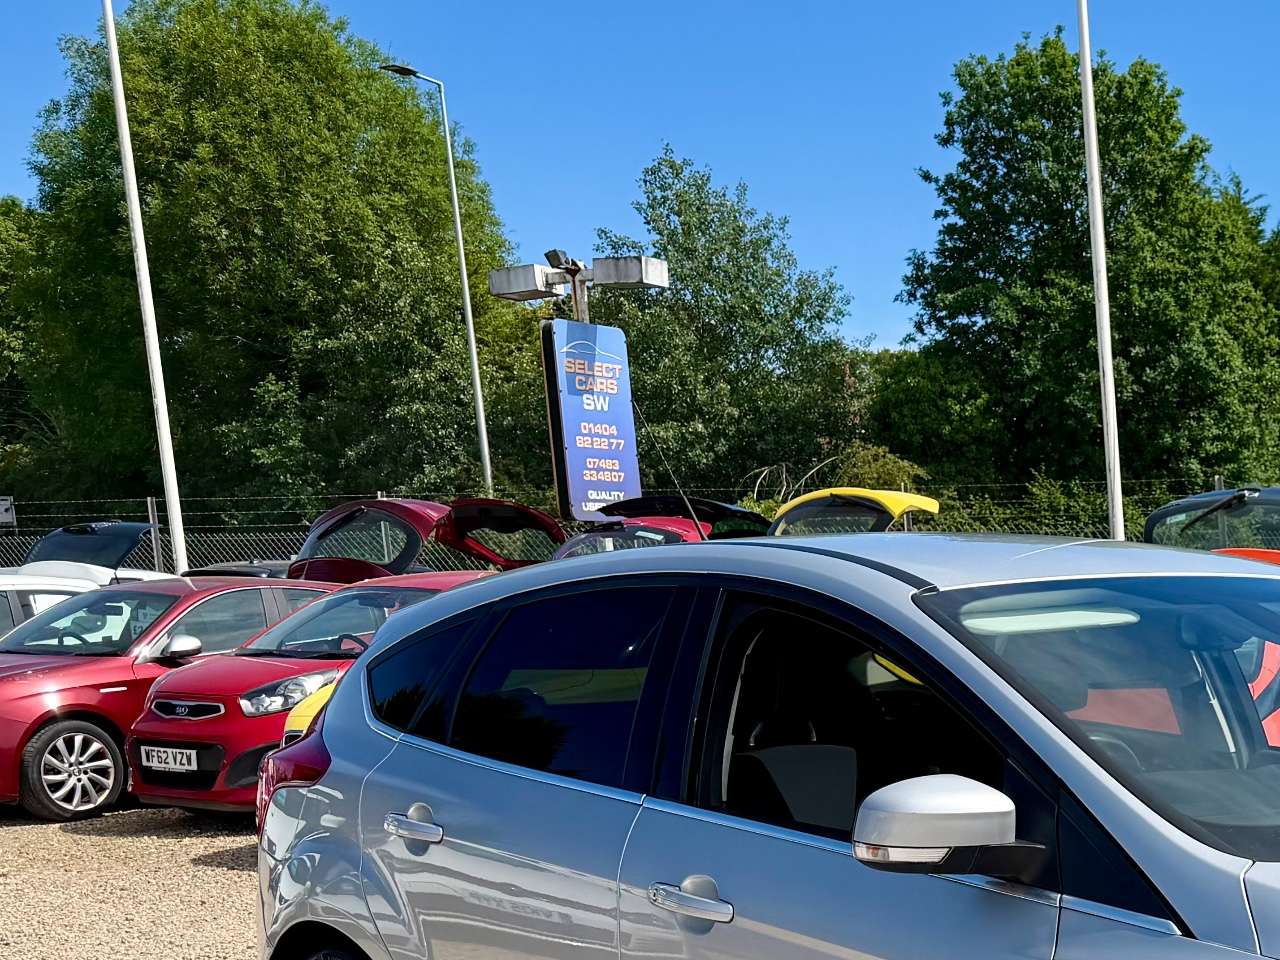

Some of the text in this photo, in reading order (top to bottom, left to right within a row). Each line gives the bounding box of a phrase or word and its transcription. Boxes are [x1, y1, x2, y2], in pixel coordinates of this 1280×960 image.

[565, 358, 622, 379] SELECT
[576, 376, 618, 394] CARS
[582, 393, 609, 411] SW
[581, 422, 617, 435] 01404
[587, 490, 624, 500] QUALITY
[144, 748, 192, 766] WF62 VZW
